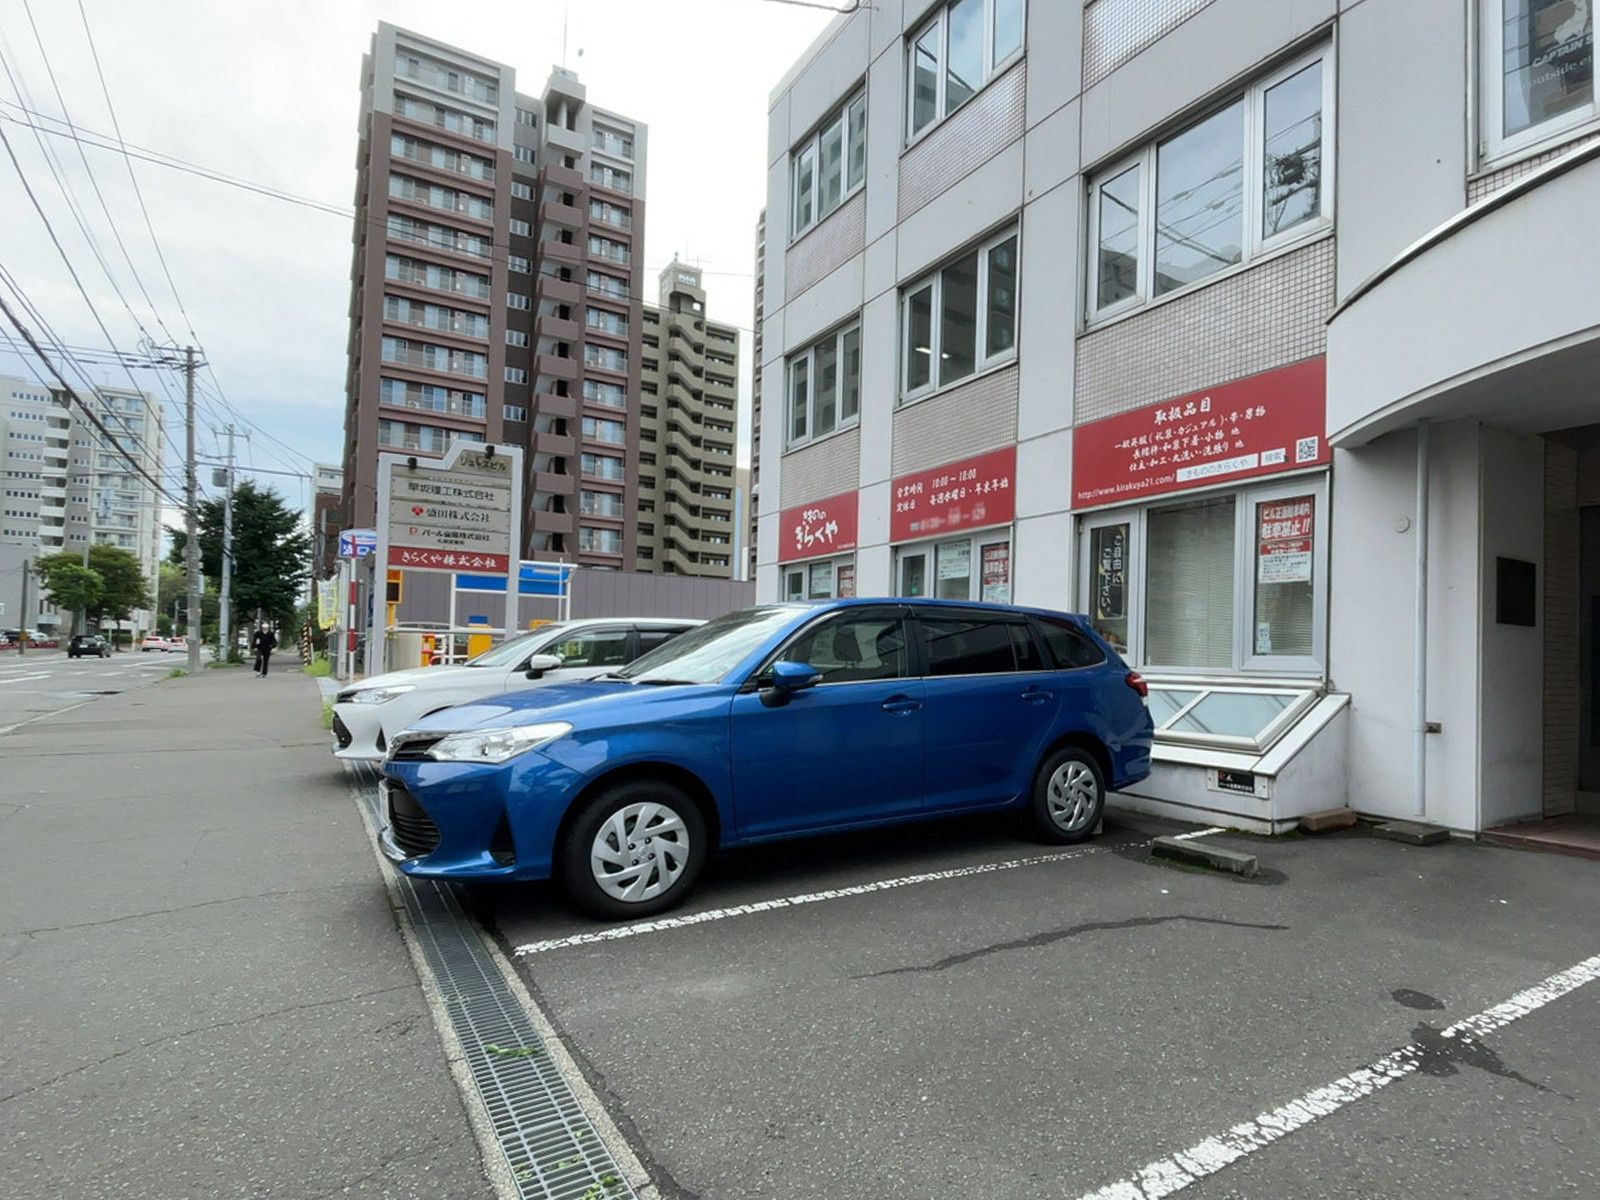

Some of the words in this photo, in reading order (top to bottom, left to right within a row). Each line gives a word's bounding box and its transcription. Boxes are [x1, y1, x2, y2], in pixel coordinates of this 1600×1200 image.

[1531, 38, 1583, 68] CAPTAIN
[1153, 396, 1211, 425] 取扱品目
[1186, 457, 1249, 479] きもののきらくや
[1264, 450, 1283, 464] 検索
[896, 482, 923, 499] 営業時間
[896, 498, 916, 513] 定休日
[929, 477, 1009, 506] 毎週水曜日・年末年始
[794, 520, 839, 550] きらくや
[401, 551, 497, 569] きらくや株式会社
[1112, 534, 1122, 583] ご自由に
